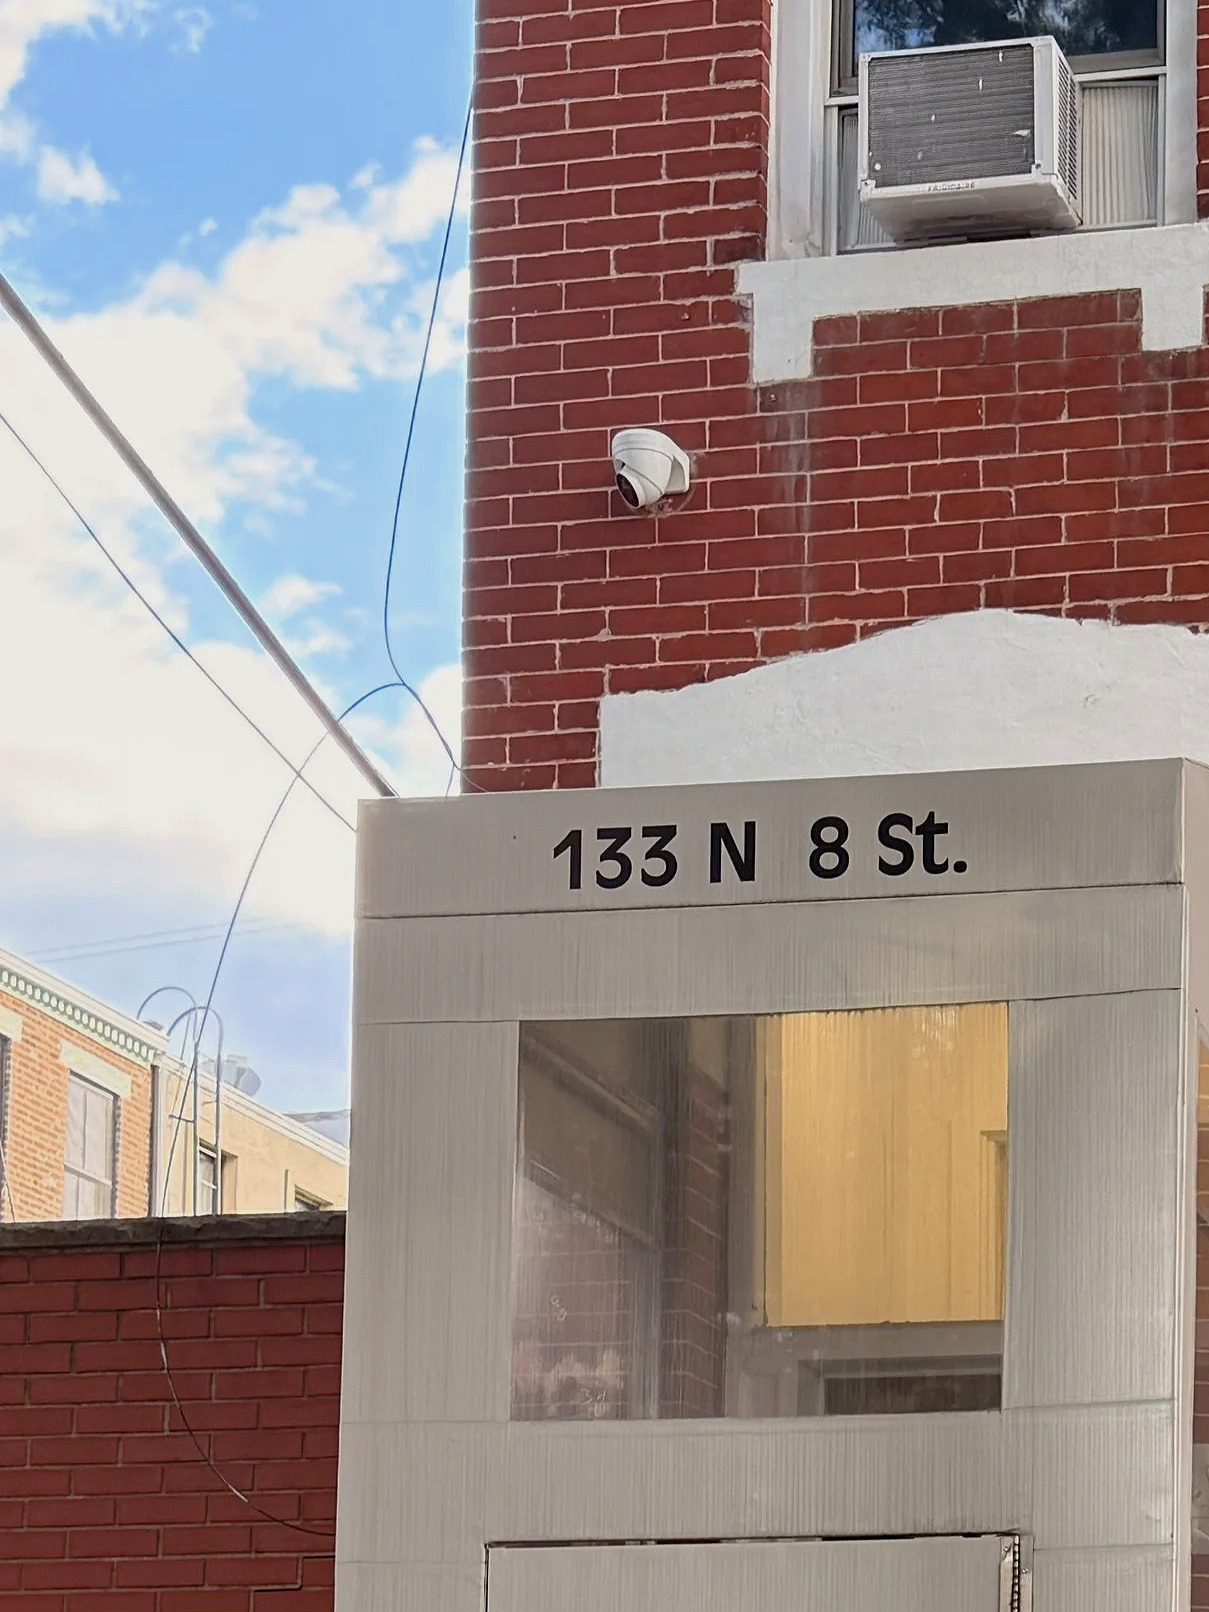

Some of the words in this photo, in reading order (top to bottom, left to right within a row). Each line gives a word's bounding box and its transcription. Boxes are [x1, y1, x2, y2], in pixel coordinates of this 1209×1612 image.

[553, 825, 677, 889] 133
[710, 820, 757, 883] N
[809, 816, 849, 879] 8
[878, 811, 968, 876] St.
